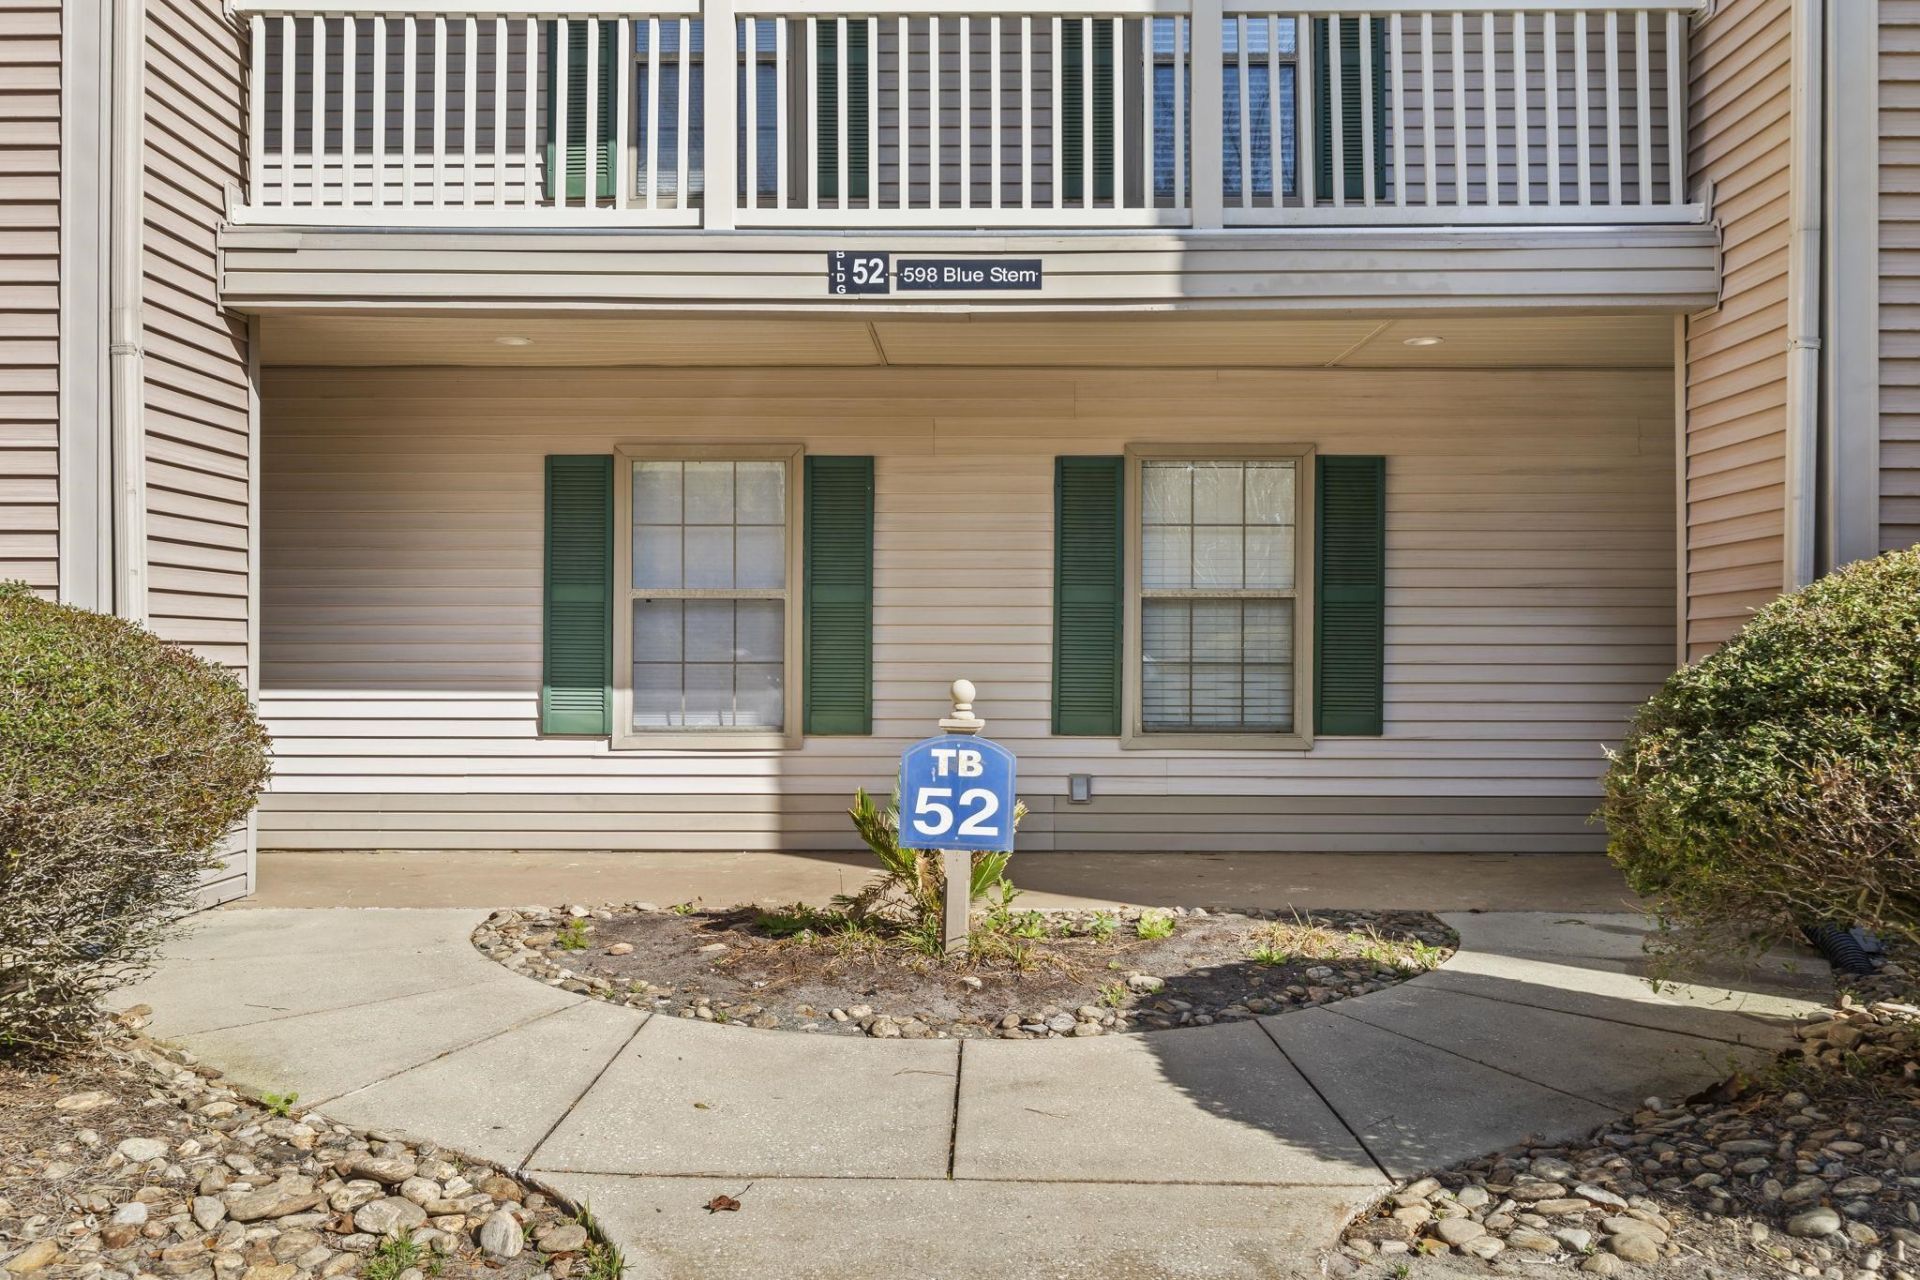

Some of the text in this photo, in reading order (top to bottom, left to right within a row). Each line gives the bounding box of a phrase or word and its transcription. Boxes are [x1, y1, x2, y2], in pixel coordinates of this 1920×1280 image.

[852, 258, 885, 284] 52
[903, 267, 1036, 283] 598 Blue Stem
[931, 749, 984, 777] TB
[913, 787, 999, 836] 52
